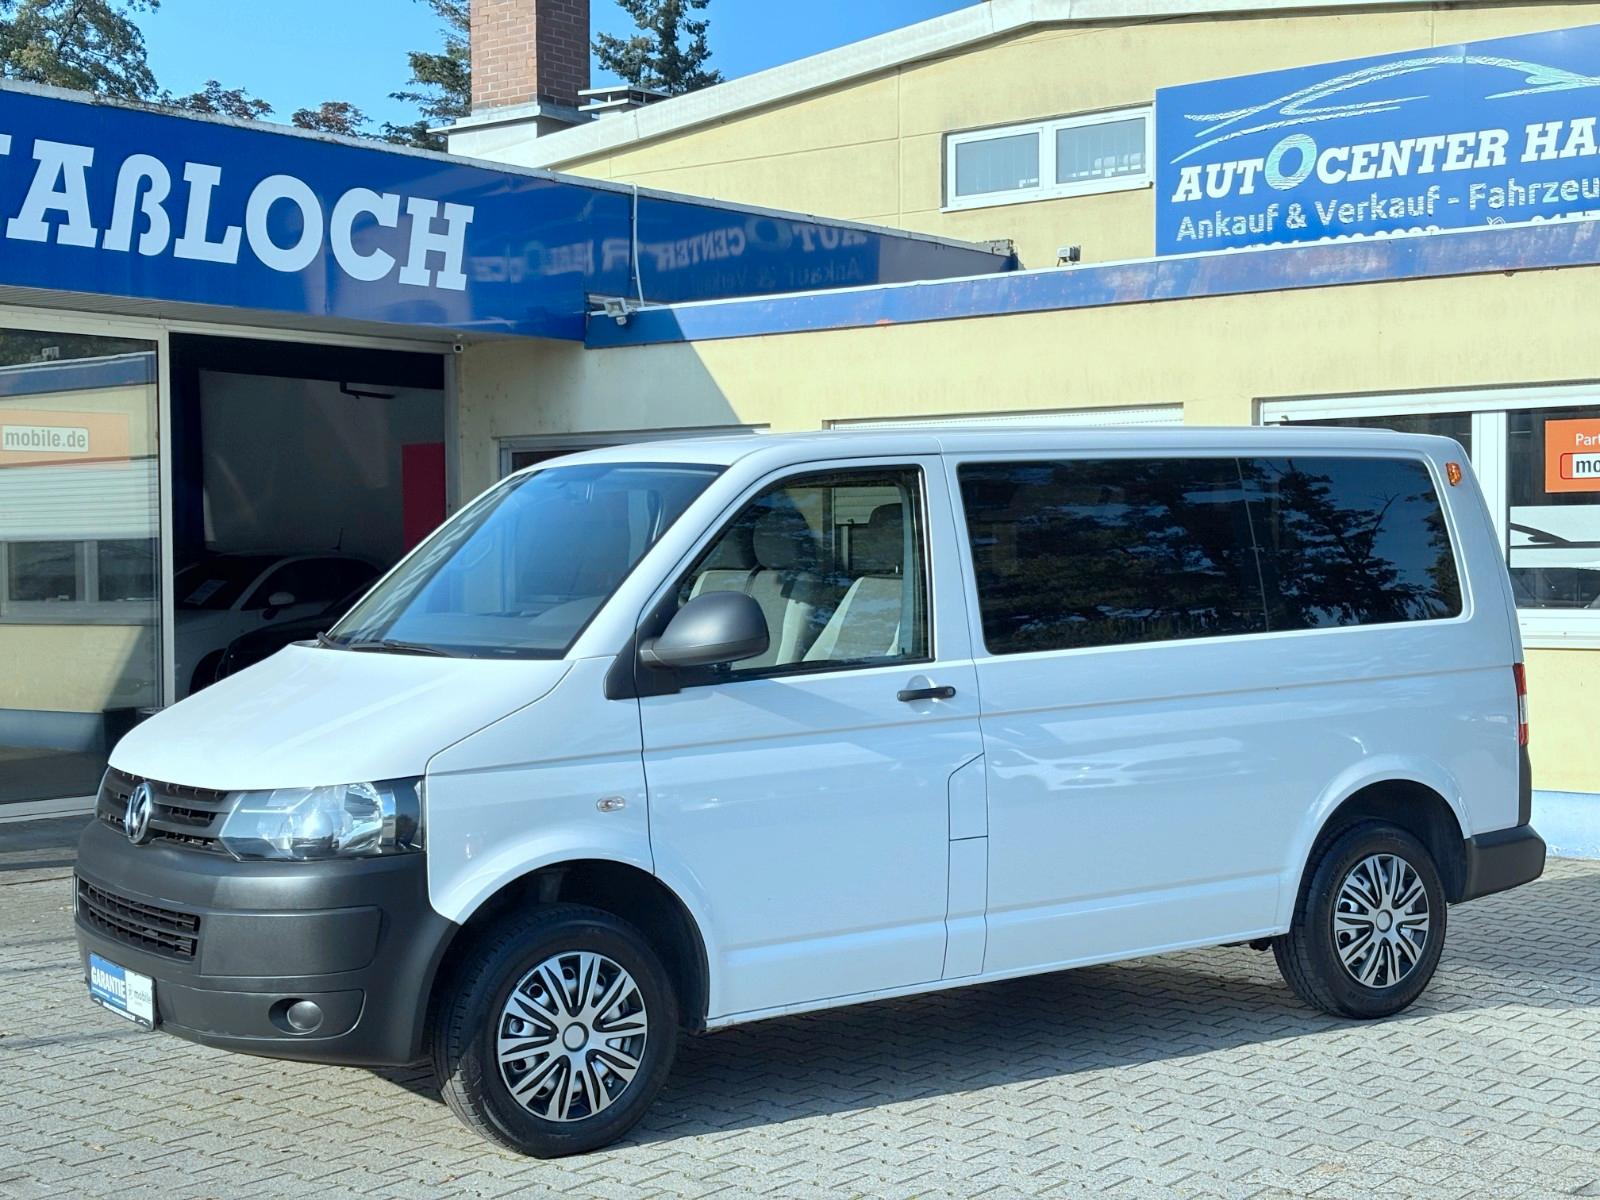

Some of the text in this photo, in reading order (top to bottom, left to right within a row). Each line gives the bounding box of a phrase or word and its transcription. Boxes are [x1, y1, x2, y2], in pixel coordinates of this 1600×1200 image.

[1171, 116, 1600, 204] AUTOCENTER HA
[0, 134, 475, 291] AßLOCH
[1175, 202, 1280, 242] Ankauf
[1286, 202, 1307, 230] &
[1314, 184, 1441, 226] Verkauf
[1468, 177, 1600, 211] Fahrzeu
[4, 429, 87, 448] mobile.de
[91, 966, 127, 999] GARANTIE
